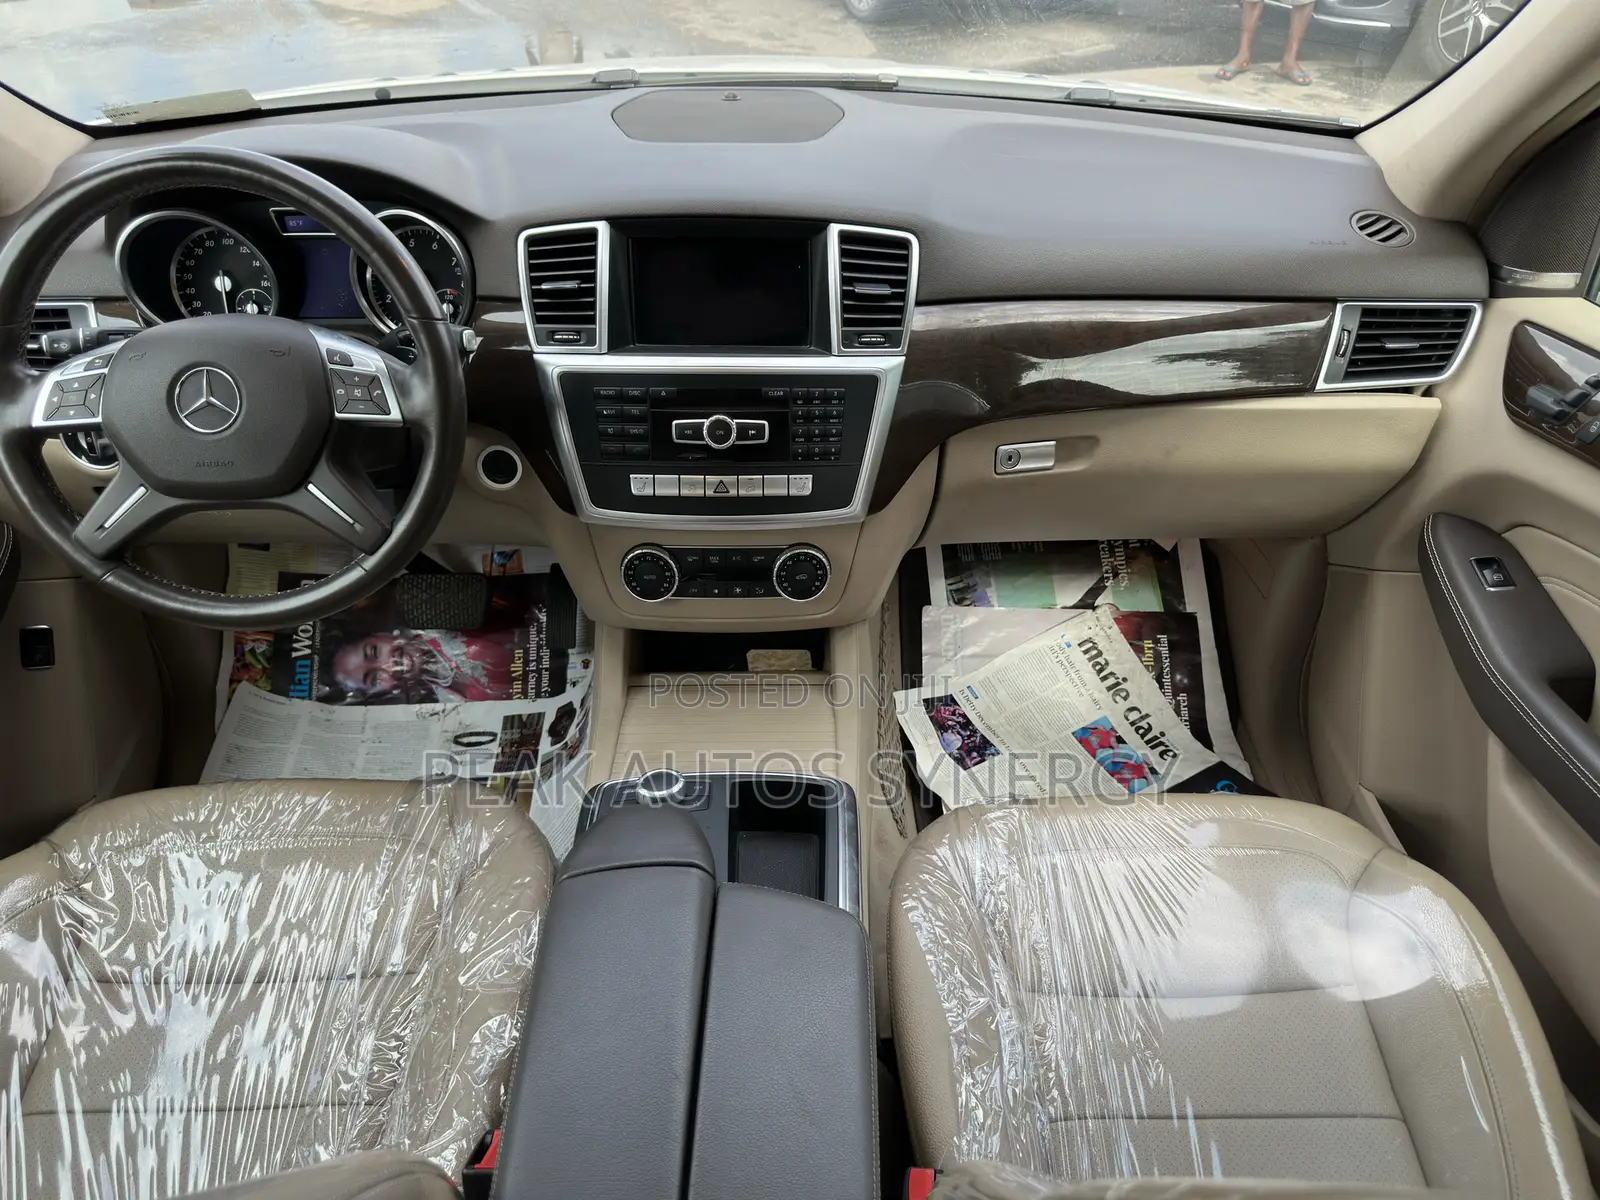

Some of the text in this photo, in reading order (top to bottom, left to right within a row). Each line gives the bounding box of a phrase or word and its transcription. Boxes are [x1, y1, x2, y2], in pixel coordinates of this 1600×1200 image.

[409, 239, 415, 247] 5
[432, 241, 438, 250] 6
[452, 257, 457, 266] 7
[510, 649, 523, 679] Allen
[526, 661, 537, 670] is
[1064, 654, 1077, 669] hair
[1074, 669, 1087, 688] from
[541, 669, 551, 692] your
[1056, 659, 1085, 697] perspective
[1077, 637, 1177, 761] marie claire
[959, 688, 966, 697] Is
[964, 695, 977, 712] Detty
[975, 711, 1001, 739] December
